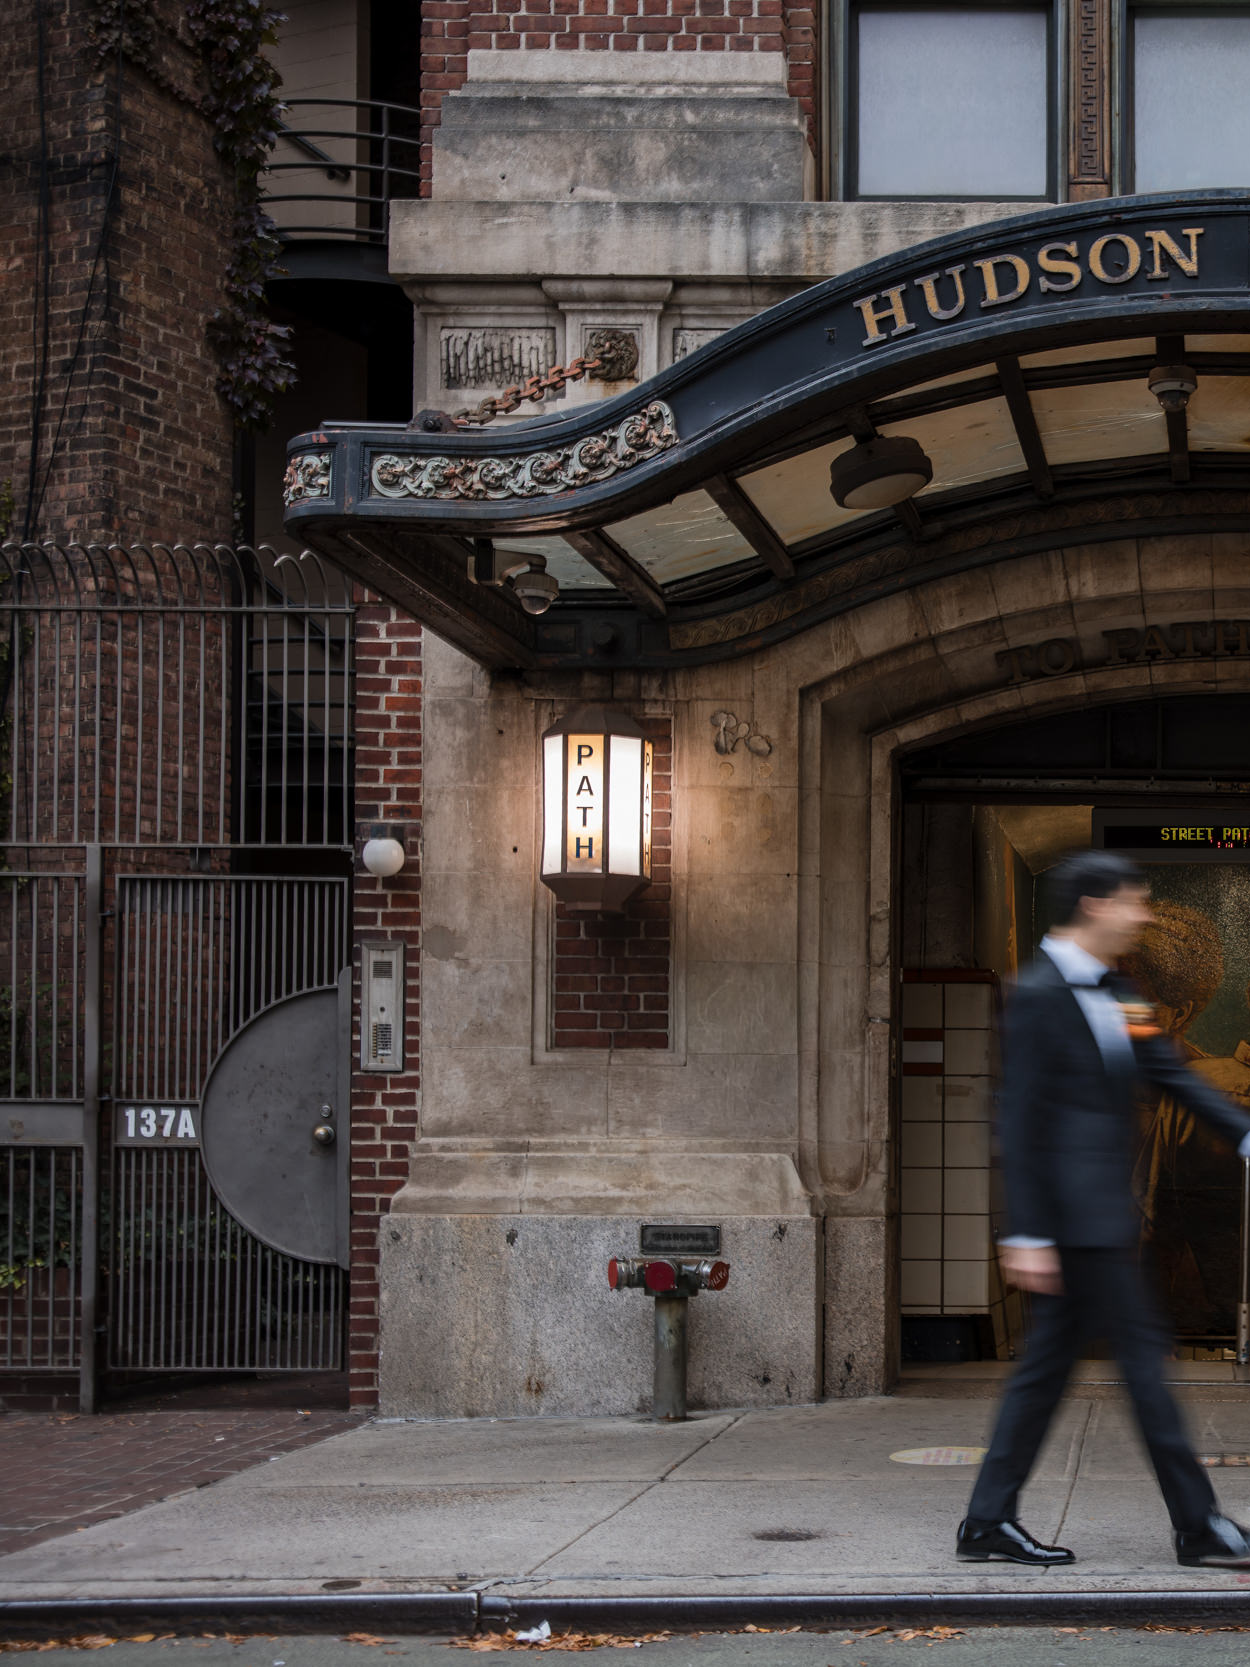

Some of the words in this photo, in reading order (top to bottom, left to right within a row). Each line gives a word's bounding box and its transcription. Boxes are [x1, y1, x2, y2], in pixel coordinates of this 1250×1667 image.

[852, 227, 1205, 347] HUDSON
[994, 637, 1076, 686] TO
[575, 744, 594, 858] PATH
[1160, 827, 1214, 841] STREET
[124, 1107, 196, 1138] 137A
